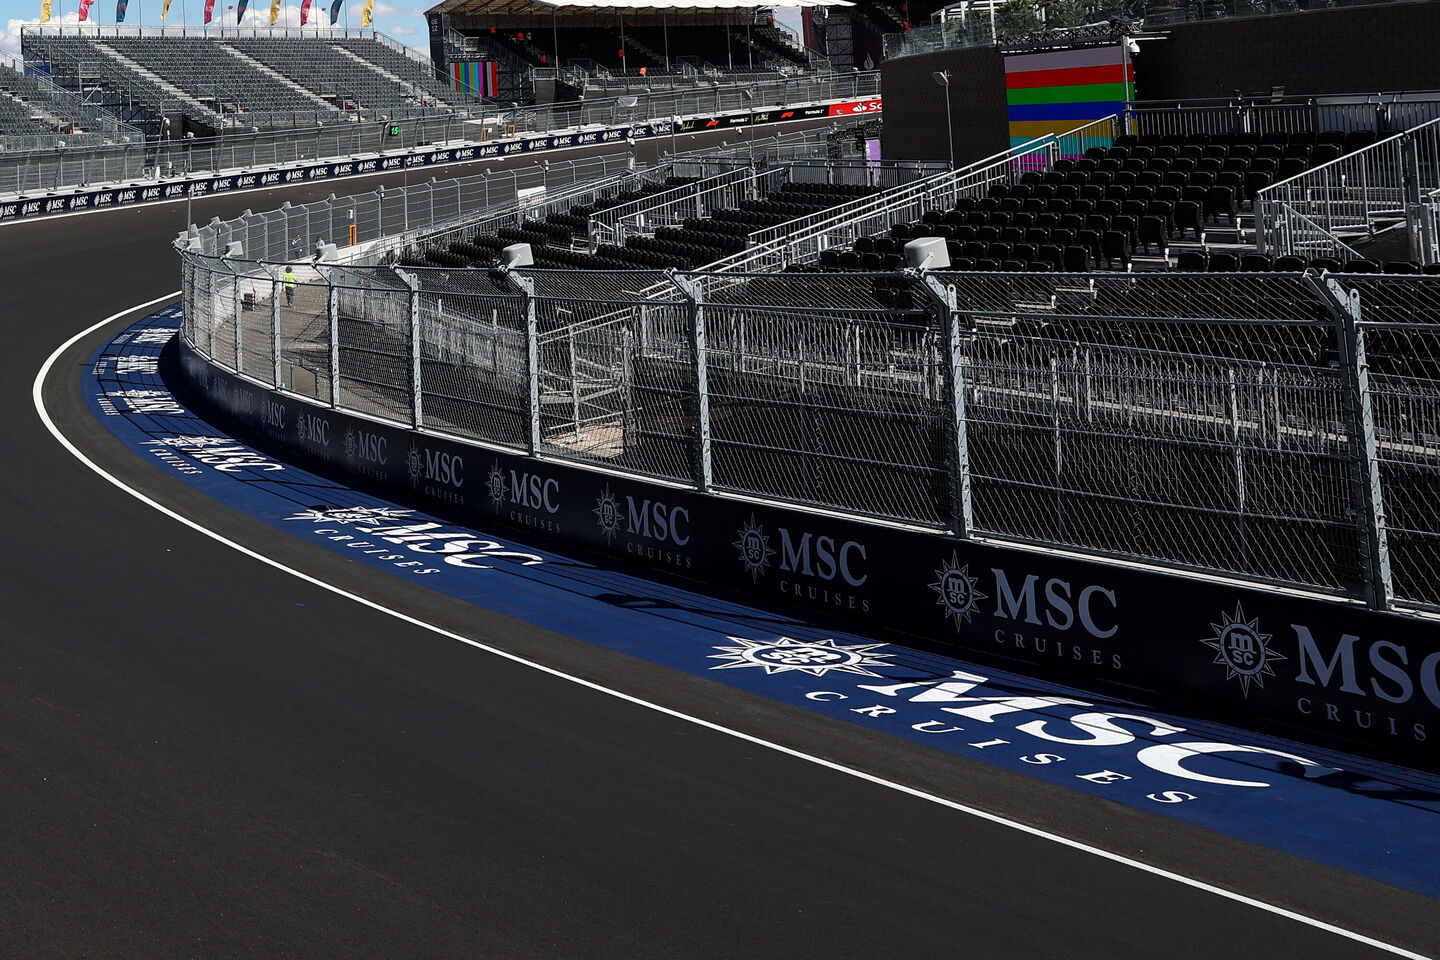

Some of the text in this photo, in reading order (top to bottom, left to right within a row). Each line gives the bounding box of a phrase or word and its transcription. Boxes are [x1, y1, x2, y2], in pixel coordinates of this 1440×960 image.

[390, 127, 399, 135] 15
[633, 128, 646, 136] MSC
[658, 124, 671, 133] MSC
[583, 133, 596, 142] MSC
[608, 130, 621, 139] MSC
[534, 139, 547, 148] MSC
[559, 136, 572, 145] MSC
[486, 145, 499, 155] MSC
[510, 143, 523, 151] MSC
[436, 152, 450, 161] MSC
[461, 149, 474, 157] MSC
[388, 158, 401, 167] MSC
[412, 155, 425, 164] MSC
[340, 164, 352, 173] MSC
[363, 161, 376, 170] MSC
[291, 170, 304, 179] MSC
[315, 167, 328, 176] MSC
[242, 175, 255, 185] MSC
[267, 173, 280, 182] MSC
[194, 182, 207, 191] MSC
[218, 178, 231, 188] MSC
[147, 188, 160, 197] MSC
[171, 185, 183, 194] MSC
[100, 193, 112, 203] MSC
[123, 190, 136, 200] MSC
[51, 199, 65, 210] MSC
[75, 196, 89, 206] MSC
[3, 205, 17, 216] MSC
[28, 202, 40, 212] MSC
[267, 399, 287, 429] MSC
[307, 414, 330, 446] MSC
[358, 430, 387, 466] MSC
[425, 448, 464, 488] MSC
[510, 469, 560, 514] MSC
[510, 510, 561, 534] CRUISES
[626, 495, 690, 546] MSC
[355, 522, 544, 569] MSC
[313, 528, 441, 575] CRUISES
[627, 542, 692, 569] CRUISES
[778, 527, 868, 586] MSC
[780, 580, 869, 612] CRUISES
[991, 568, 1119, 639] MSC
[995, 629, 1122, 670] CRUISES
[1297, 697, 1427, 741] CRUIS
[858, 669, 1344, 788] MSC
[805, 690, 1197, 804] CRUISES
